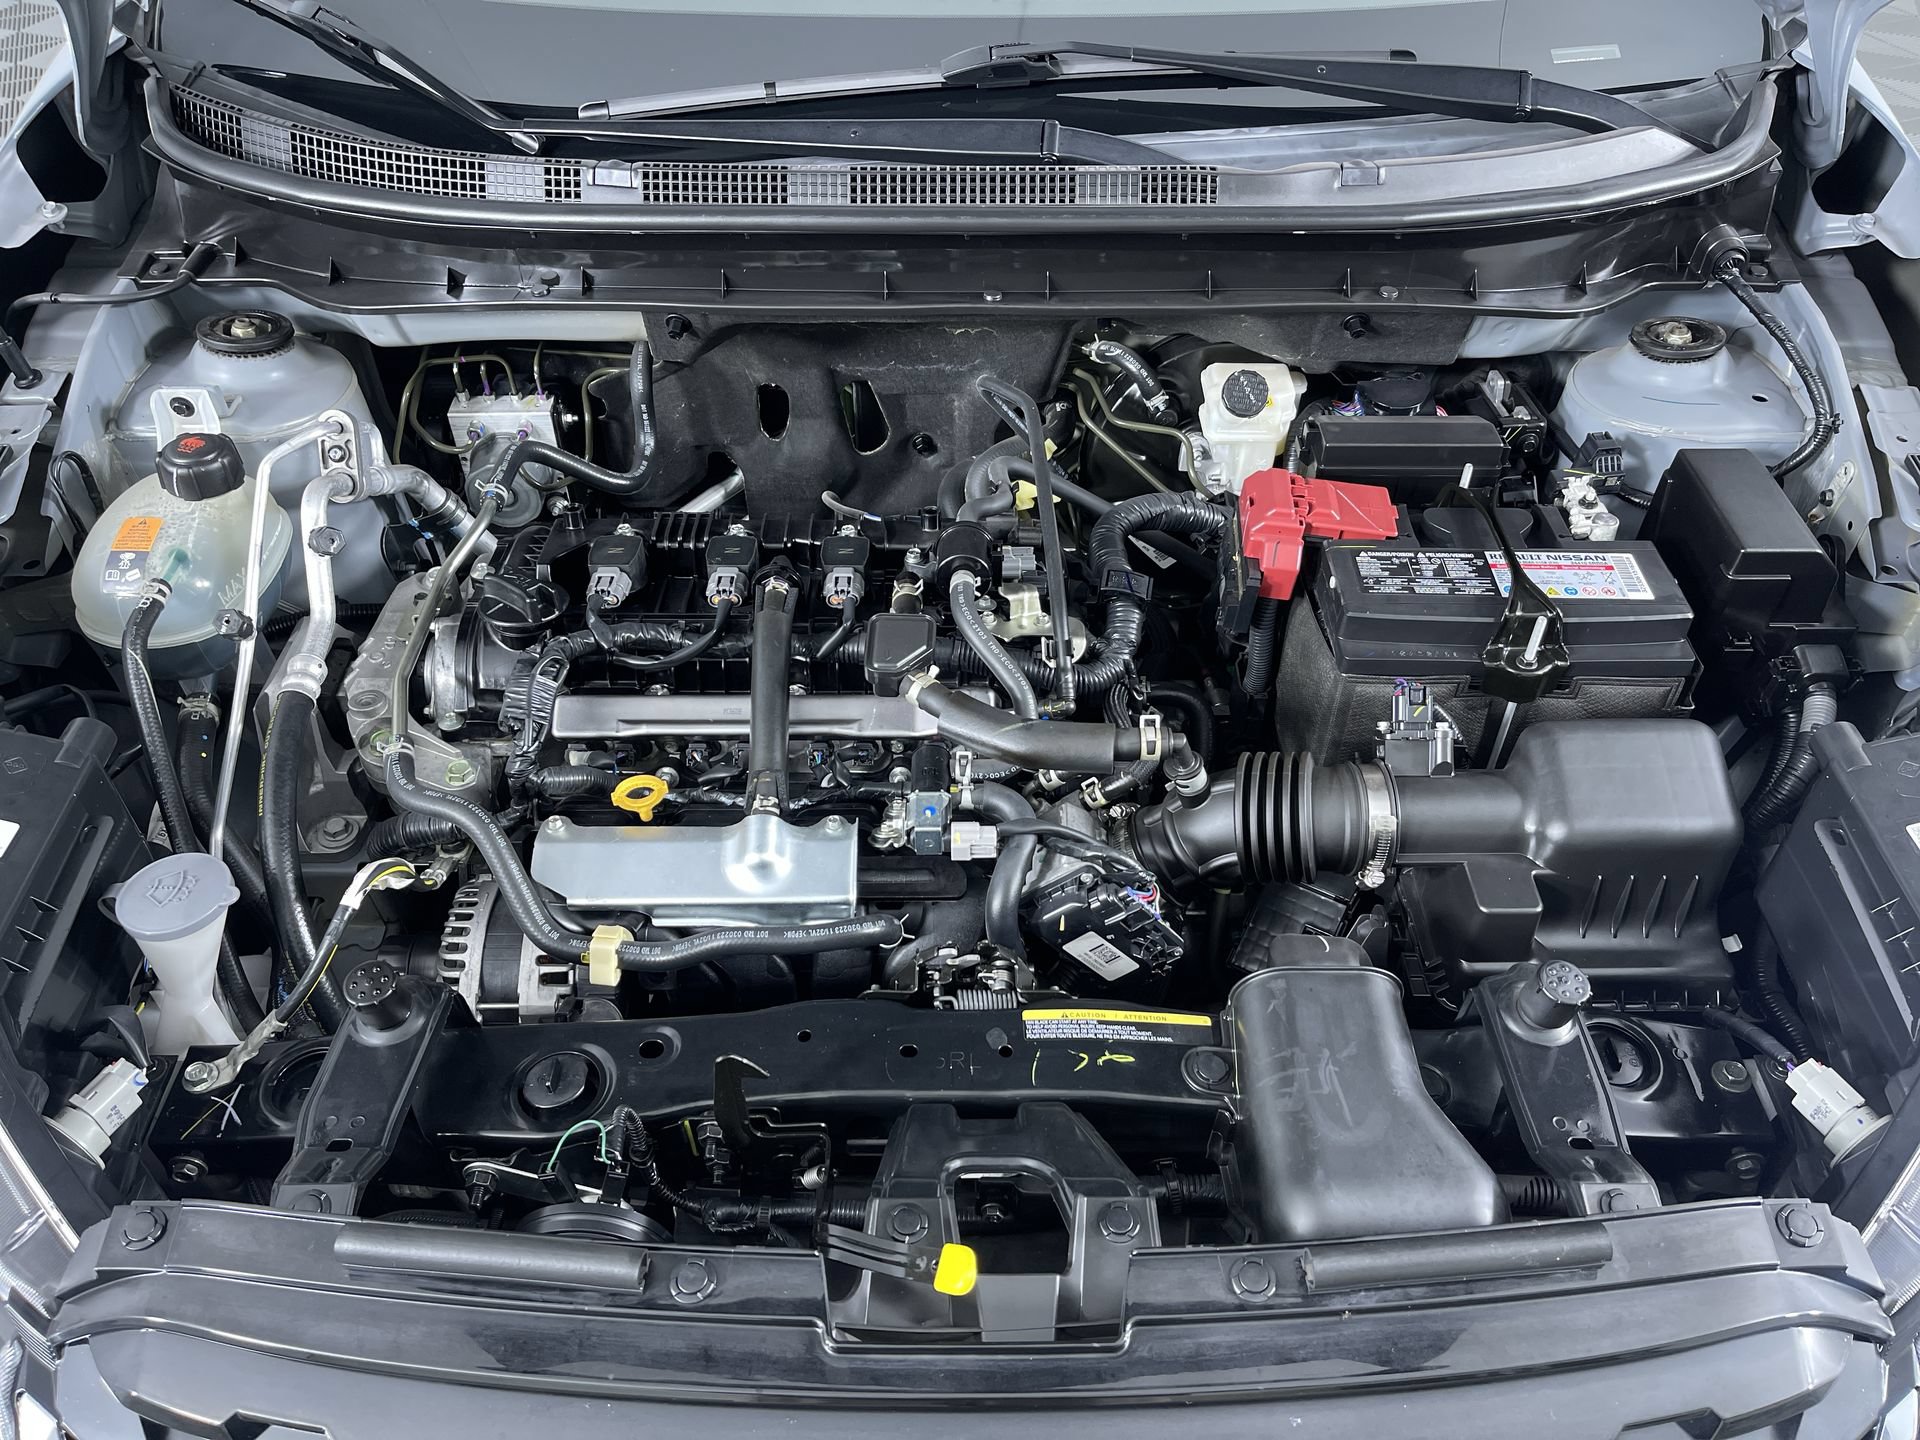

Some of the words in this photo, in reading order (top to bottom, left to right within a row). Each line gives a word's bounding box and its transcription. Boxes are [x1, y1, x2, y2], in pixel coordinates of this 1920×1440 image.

[1546, 554, 1607, 562] NISSAN
[834, 923, 860, 932] 030223
[716, 930, 742, 939] 030223
[756, 930, 769, 938] DOT
[1123, 1014, 1167, 1022] ATTENTION
